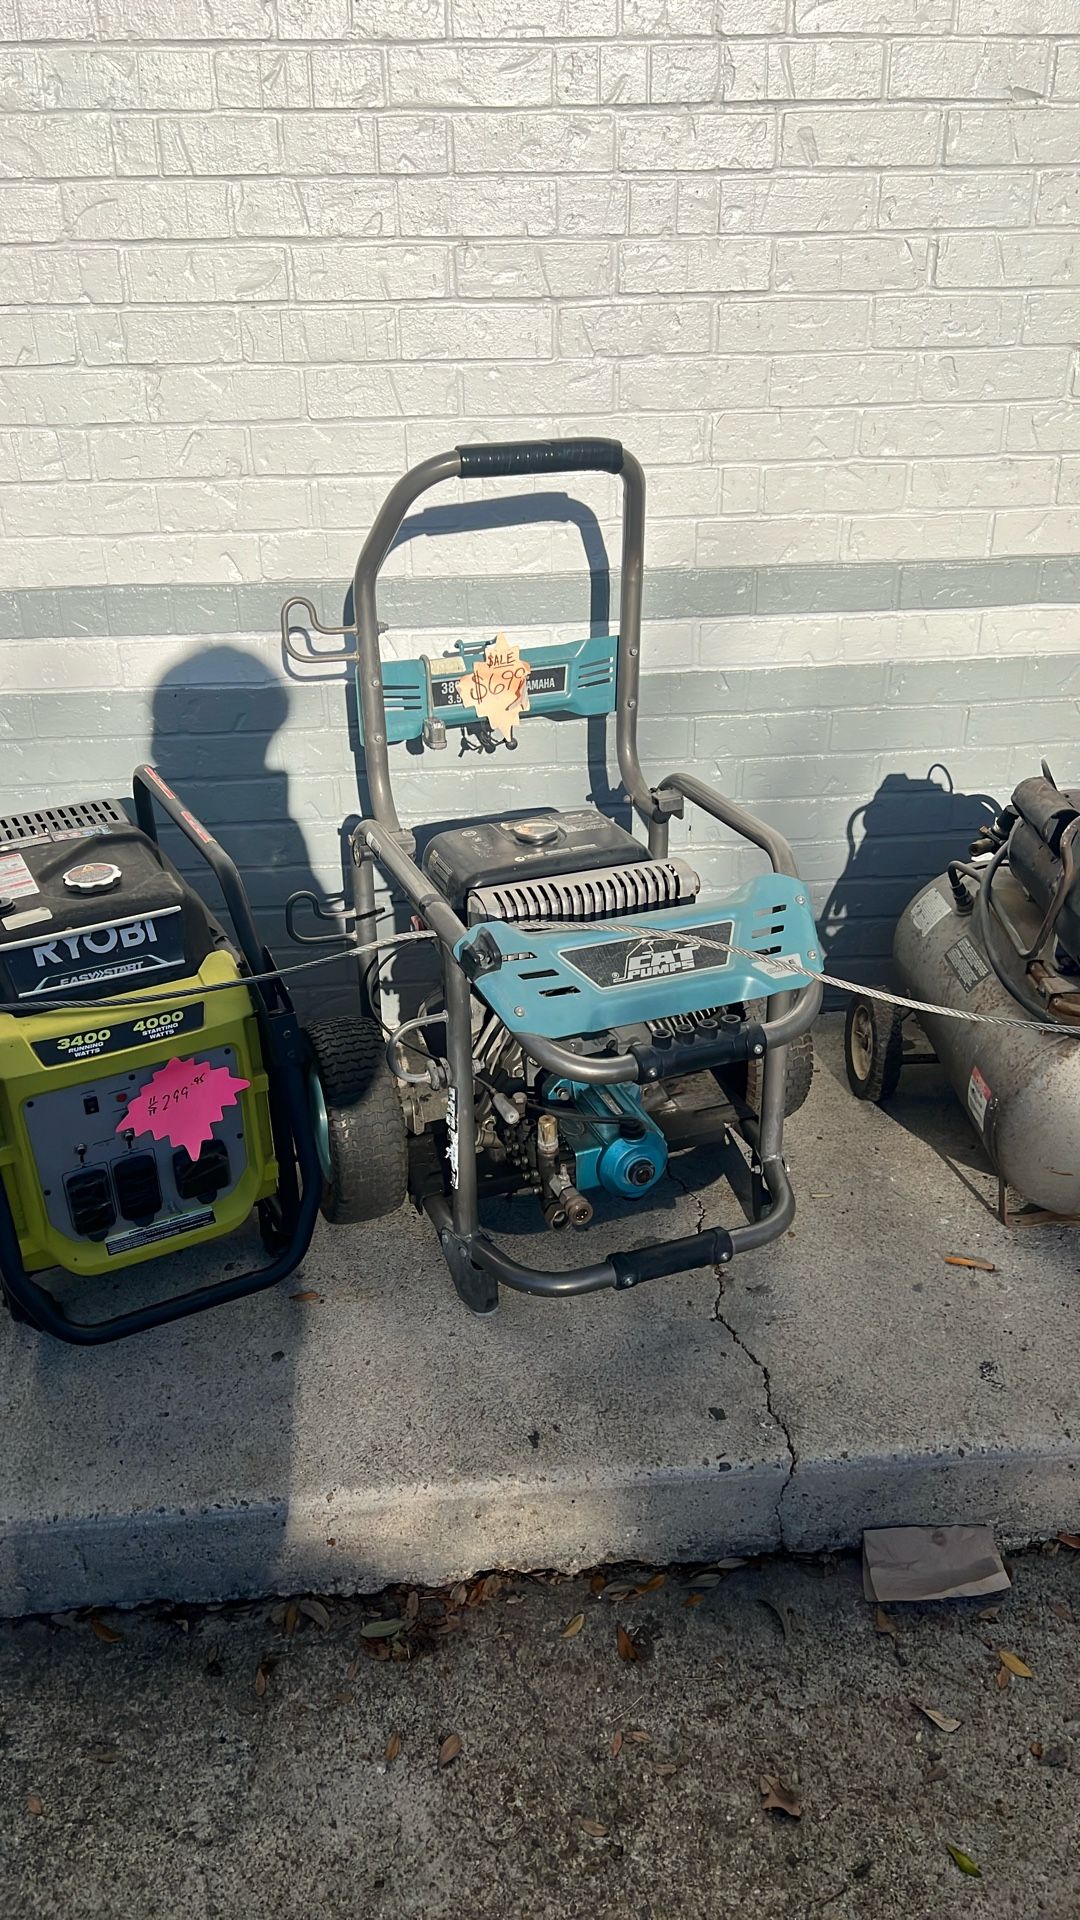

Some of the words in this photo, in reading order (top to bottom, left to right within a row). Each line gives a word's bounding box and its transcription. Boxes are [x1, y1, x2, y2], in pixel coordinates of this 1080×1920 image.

[526, 677, 556, 691] AMAHA
[33, 919, 158, 968] RYOBI
[628, 946, 701, 971] CAT
[628, 960, 696, 980] PUMPS
[133, 1010, 184, 1032] 4000
[142, 1022, 179, 1036] STARTING
[56, 1029, 111, 1050] 3400
[149, 1029, 175, 1040] WATTS
[68, 1041, 104, 1054] RUNNING
[74, 1048, 101, 1058] WATTS
